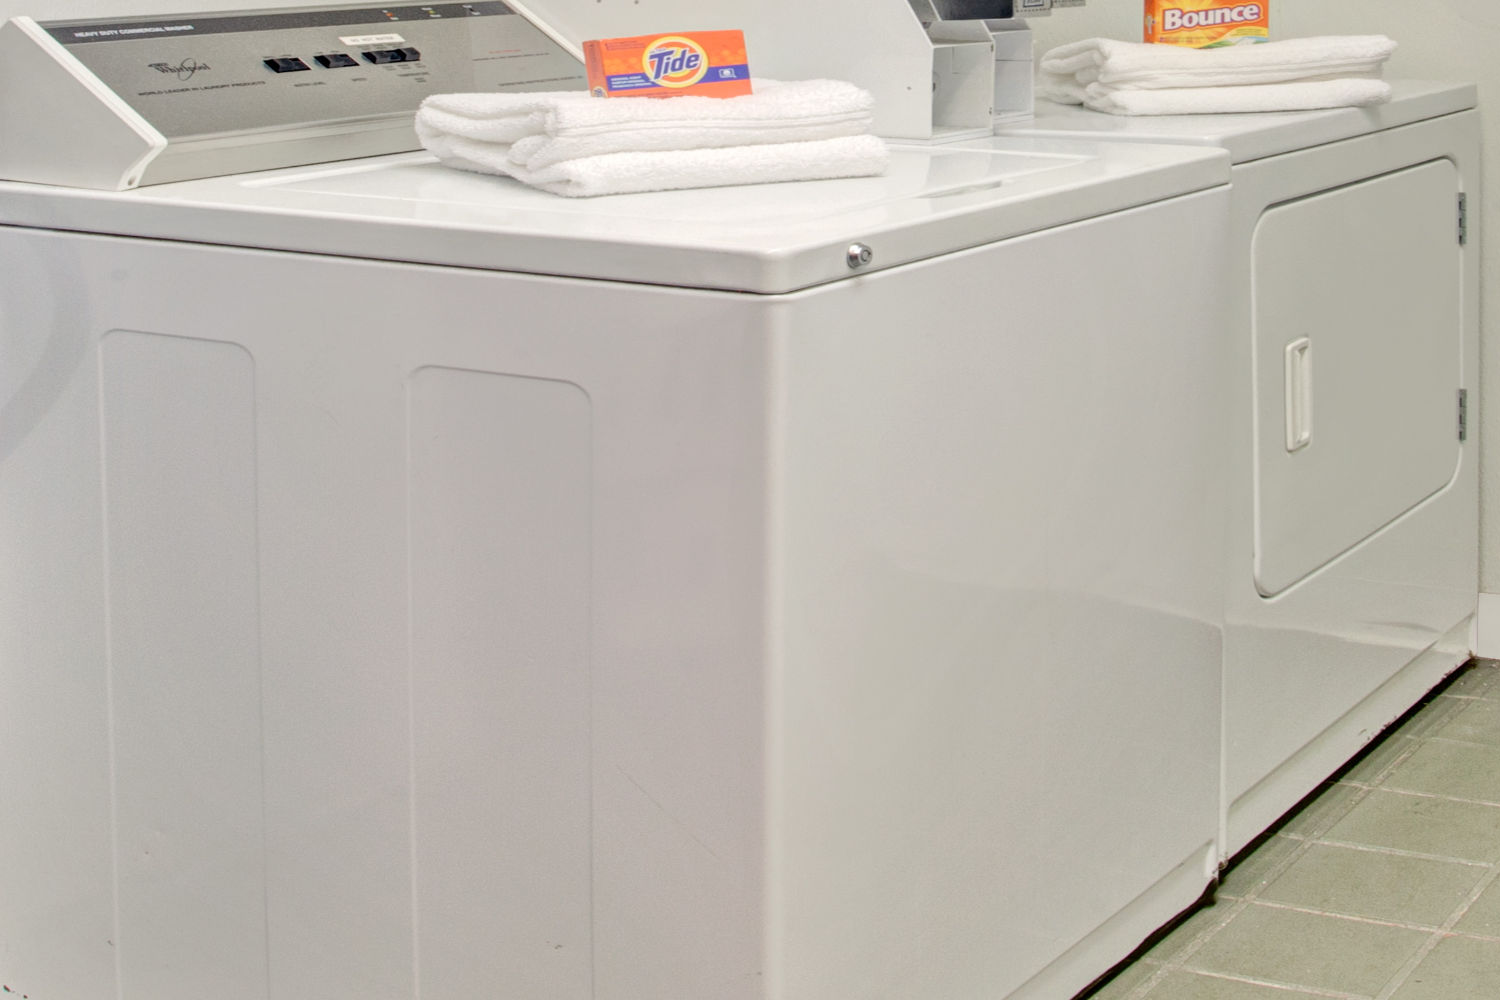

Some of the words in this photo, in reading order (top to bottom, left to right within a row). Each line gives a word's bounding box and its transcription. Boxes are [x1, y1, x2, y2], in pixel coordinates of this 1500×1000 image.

[1163, 4, 1260, 31] Bounce
[118, 26, 164, 35] COMMERCIAL
[148, 58, 211, 81] Whirlpool
[649, 48, 700, 80] Tide
